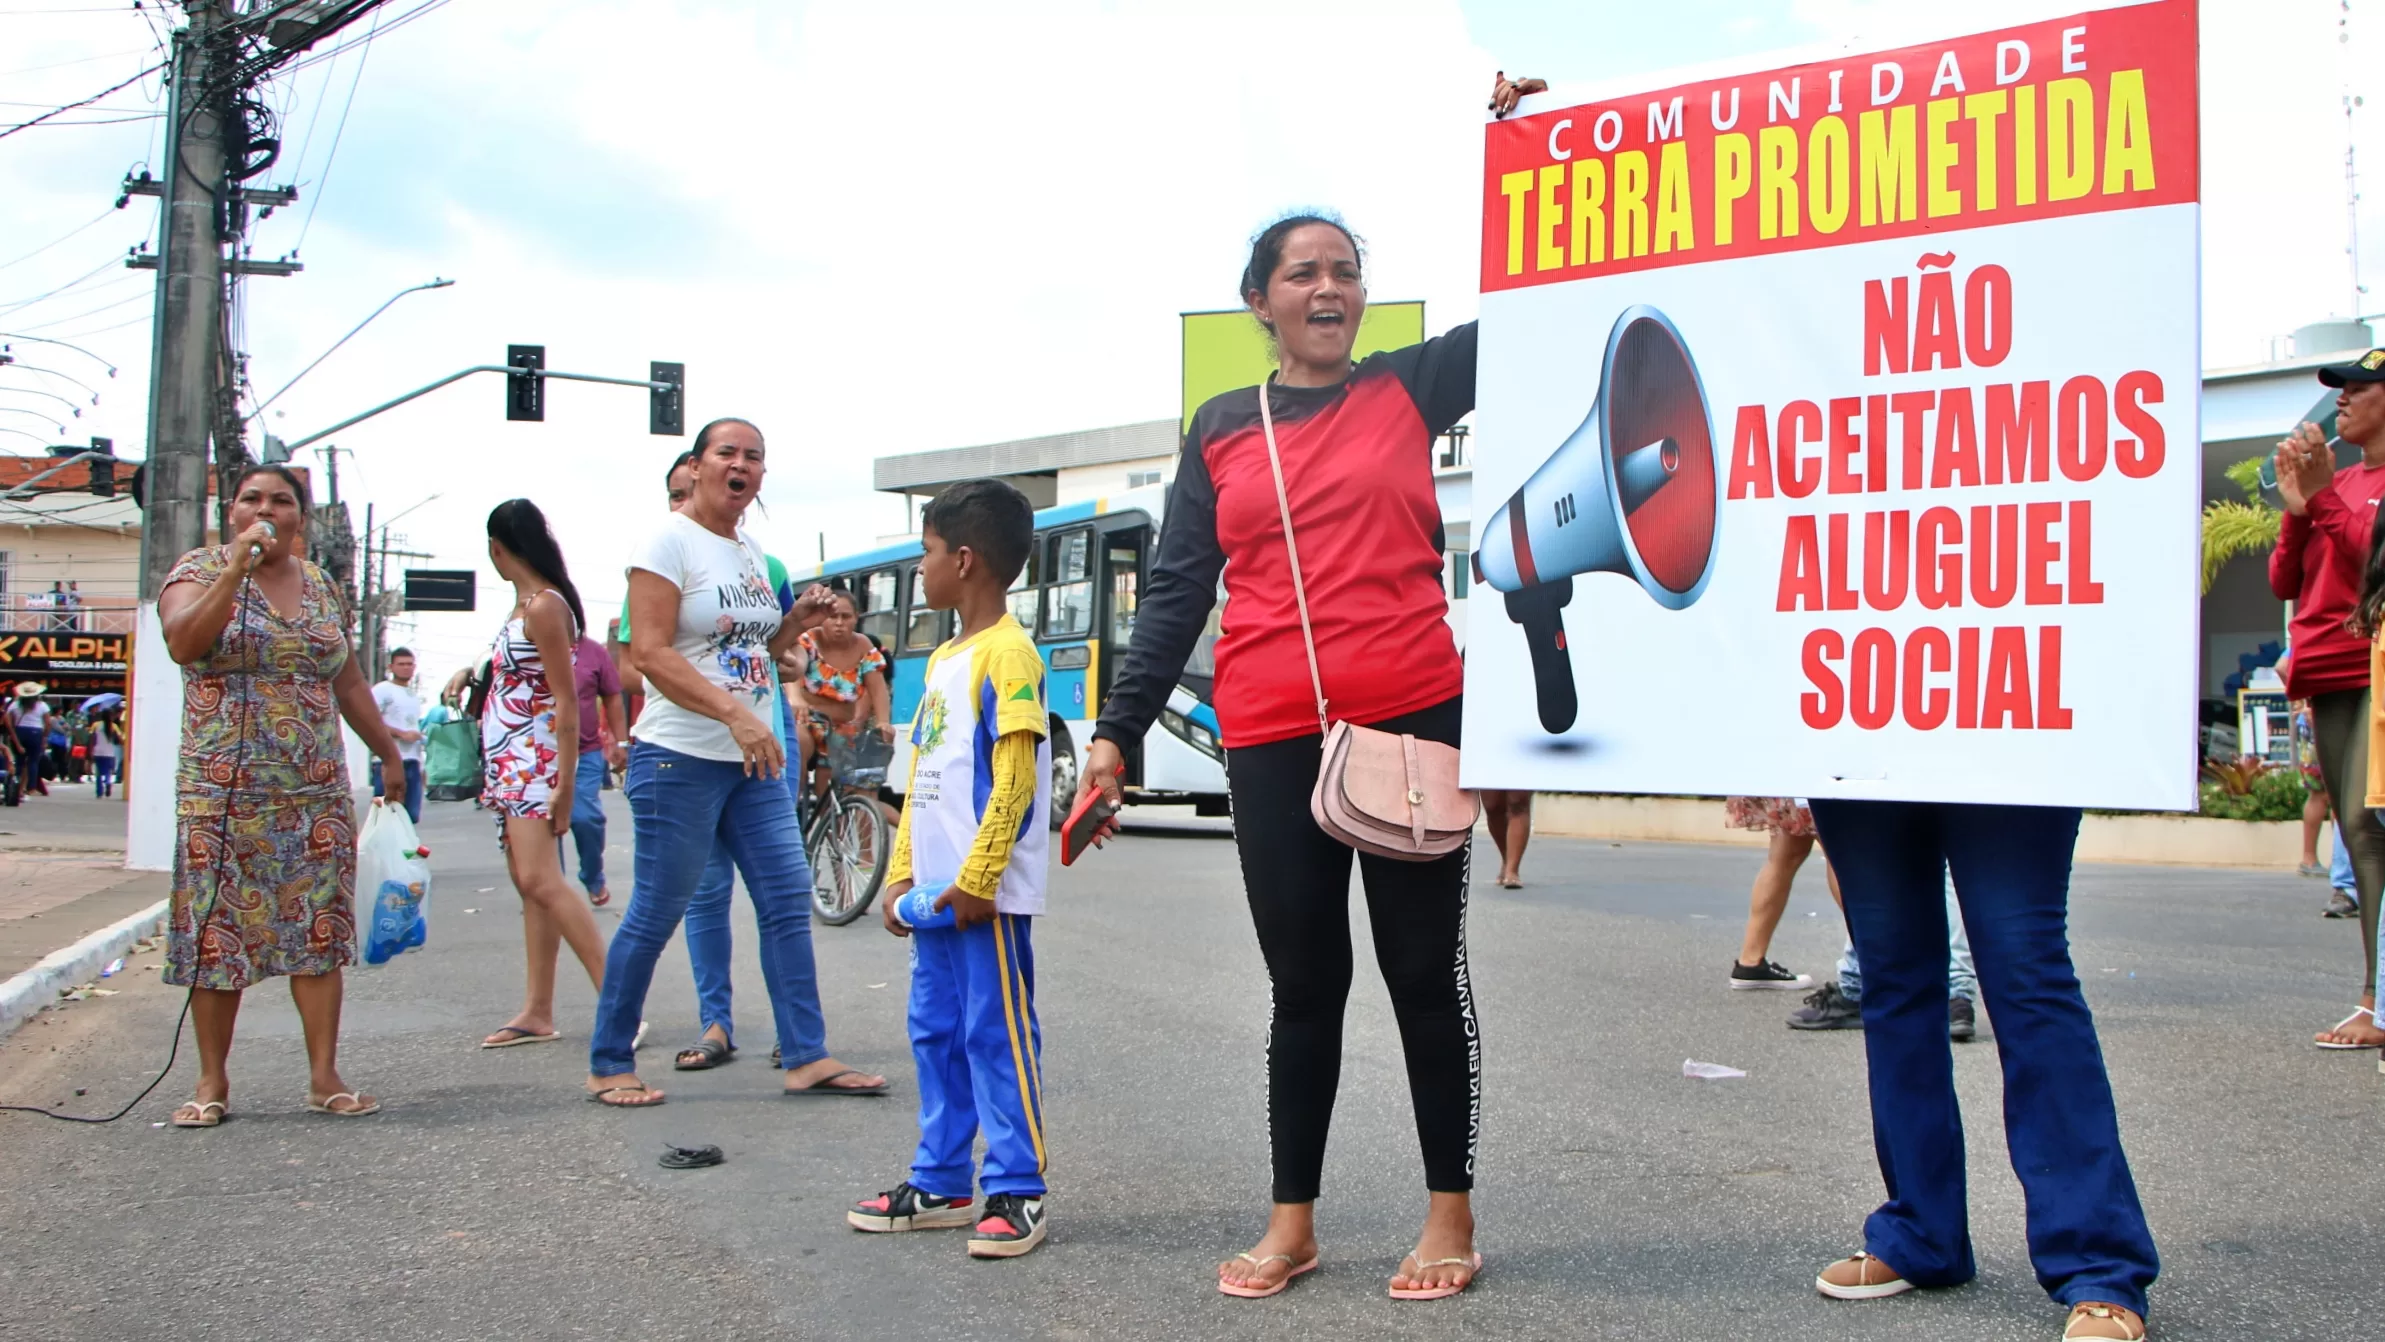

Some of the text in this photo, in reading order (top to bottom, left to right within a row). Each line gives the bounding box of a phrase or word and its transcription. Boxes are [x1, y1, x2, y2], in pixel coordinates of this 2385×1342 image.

[1547, 26, 2088, 161] COMUNIDADE
[1501, 69, 2156, 275] TERRA PROMETIDA
[1863, 250, 2013, 376] NÃO
[1727, 370, 2166, 500] ACEITAMOS
[1776, 501, 2104, 613] ALUGUEL
[18, 636, 128, 661] ALPH
[1800, 625, 2073, 731] SOCIAL
[1453, 963, 1477, 1037] CALVIN
[1467, 1039, 1481, 1097] KLEIN
